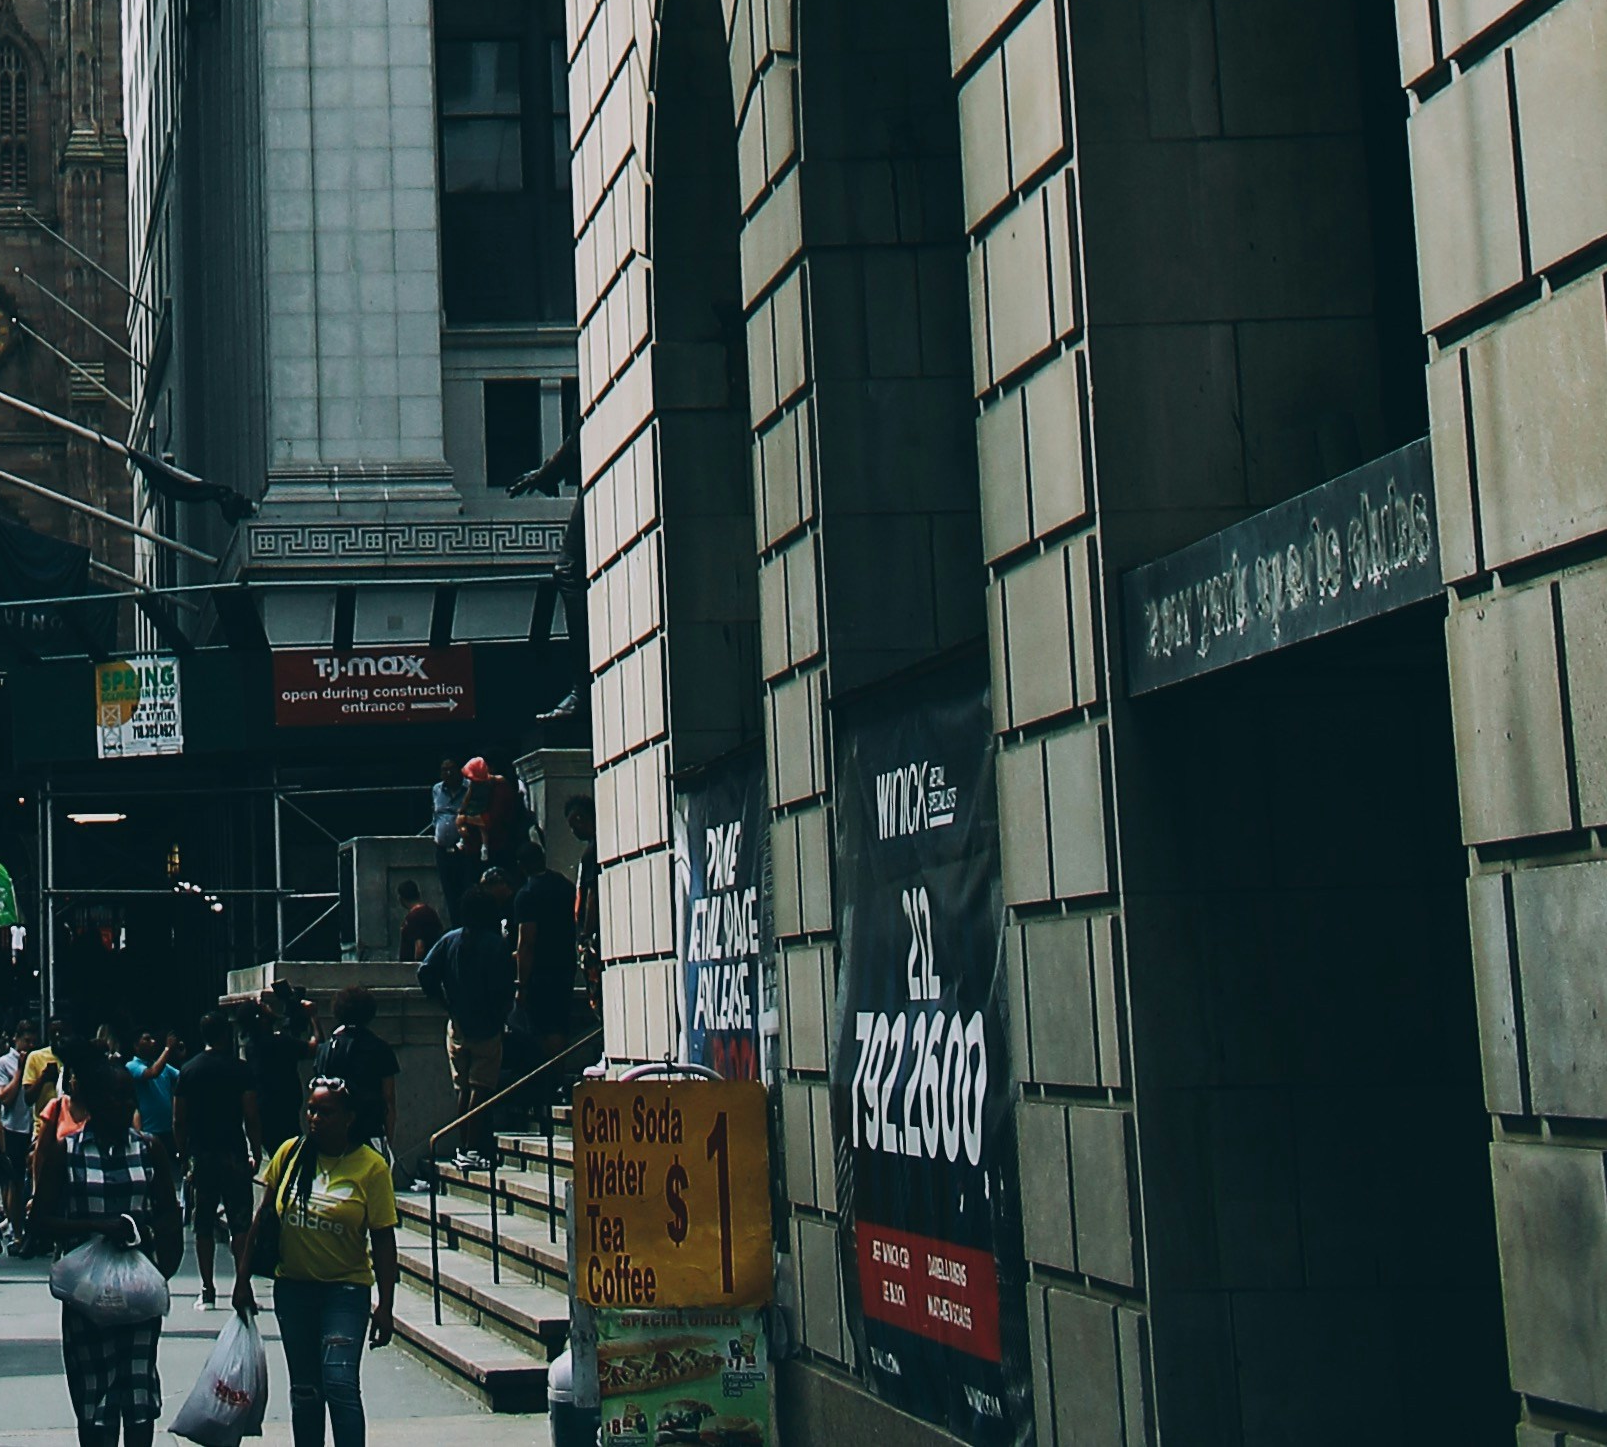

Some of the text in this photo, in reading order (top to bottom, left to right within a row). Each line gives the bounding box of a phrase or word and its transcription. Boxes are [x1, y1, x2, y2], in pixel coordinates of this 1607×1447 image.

[1195, 548, 1249, 659] york
[101, 665, 175, 691] SPRING
[281, 683, 464, 703] open during construction
[341, 701, 406, 713] entrance
[901, 886, 942, 1001] 212
[852, 1009, 988, 1167] 792.2600
[582, 1094, 683, 1144] Can Soda
[586, 1149, 647, 1199] Water
[586, 1203, 625, 1253] Tea
[587, 1253, 657, 1305] Coffee
